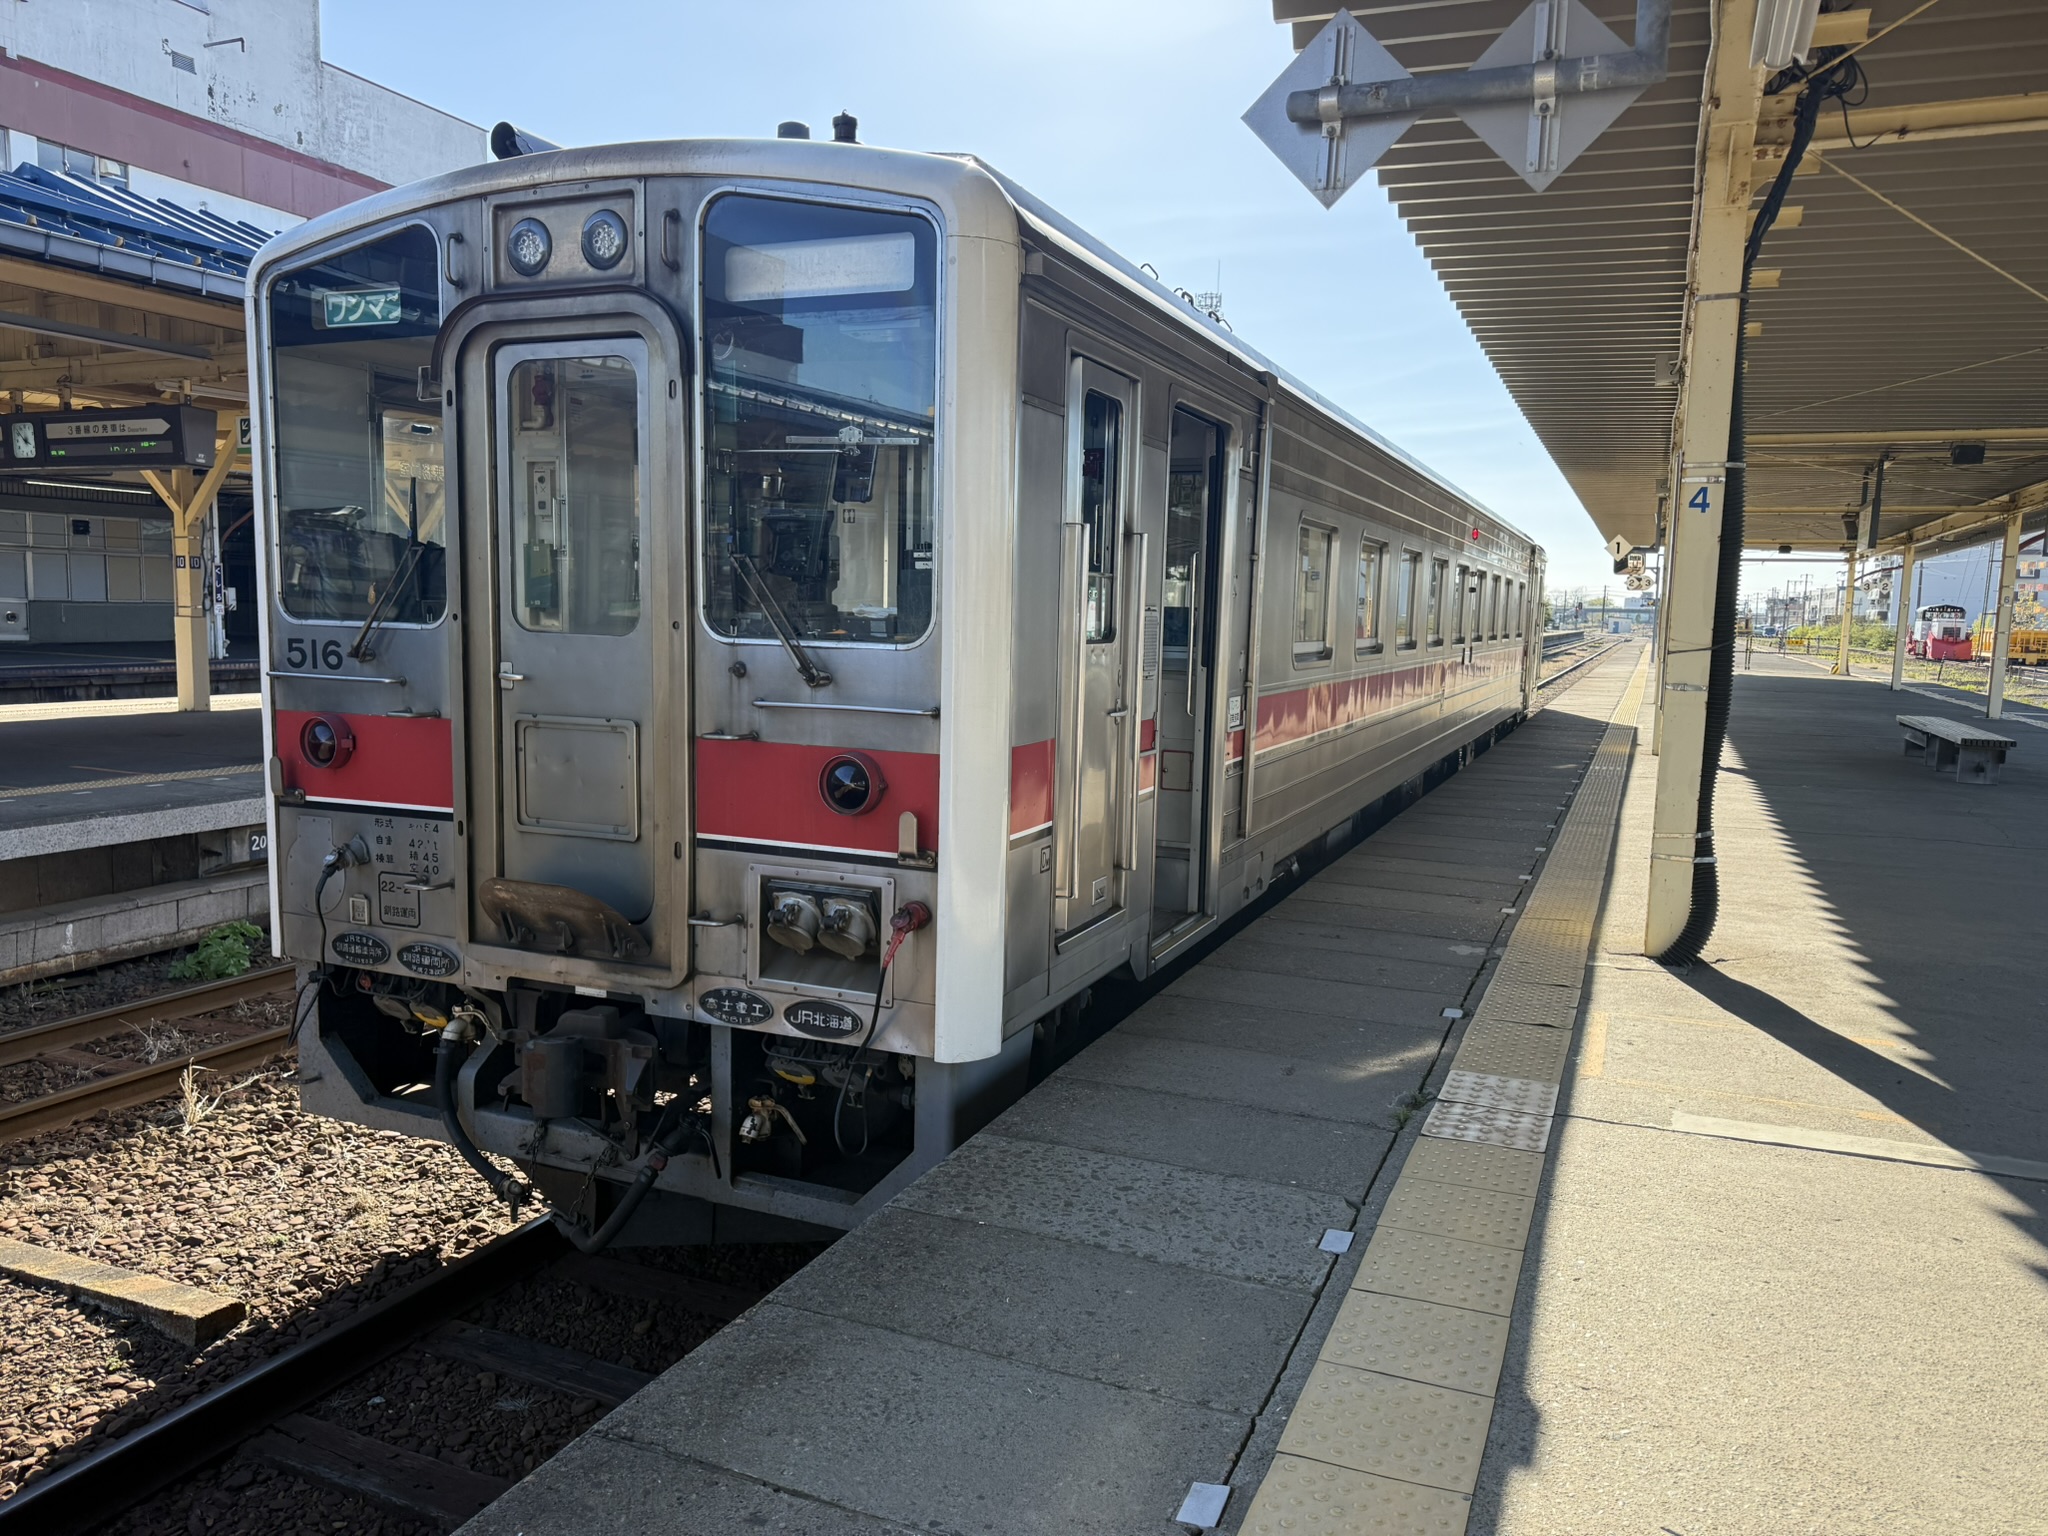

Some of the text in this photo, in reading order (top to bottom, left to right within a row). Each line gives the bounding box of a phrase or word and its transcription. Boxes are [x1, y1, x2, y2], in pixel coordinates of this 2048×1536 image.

[67, 423, 126, 435] 3番線の発車は
[1688, 486, 1710, 513] 4
[1616, 542, 1621, 554] 1
[177, 557, 184, 567] 10
[191, 558, 200, 567] 10
[1629, 579, 1635, 587] 2
[1645, 579, 1651, 587] 3
[1863, 583, 1870, 591] 3
[1882, 583, 1889, 591] 2
[286, 638, 343, 670] 516
[374, 818, 394, 829] 形式
[251, 835, 267, 851] 20
[705, 997, 764, 1018] 富士重工
[790, 1009, 853, 1032] JR北海道
